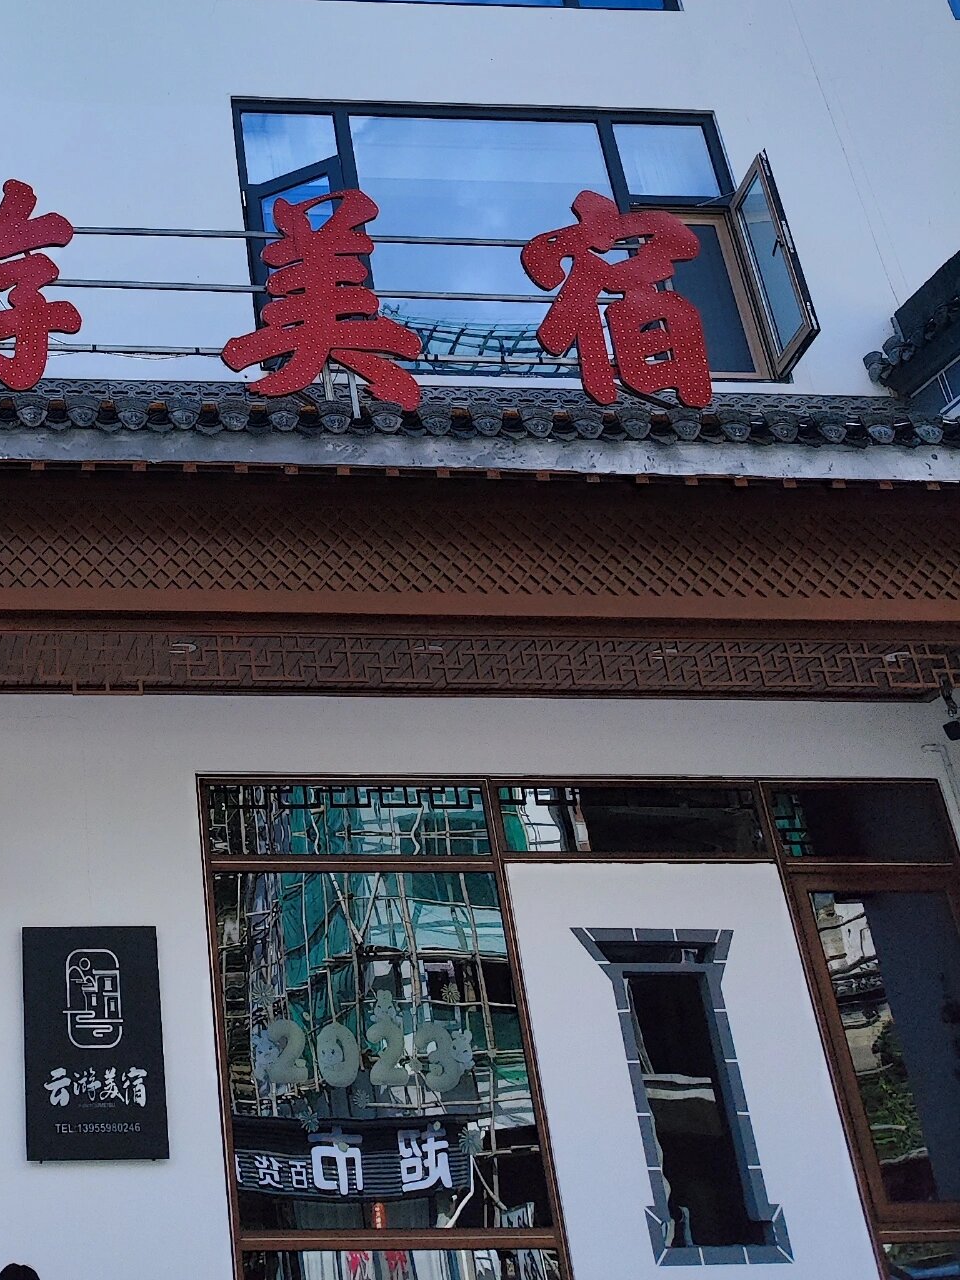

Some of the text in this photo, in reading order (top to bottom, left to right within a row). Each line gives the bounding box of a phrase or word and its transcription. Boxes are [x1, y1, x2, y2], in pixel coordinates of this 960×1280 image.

[264, 1019, 464, 1093] 2023
[44, 1067, 148, 1107] 云游美宿
